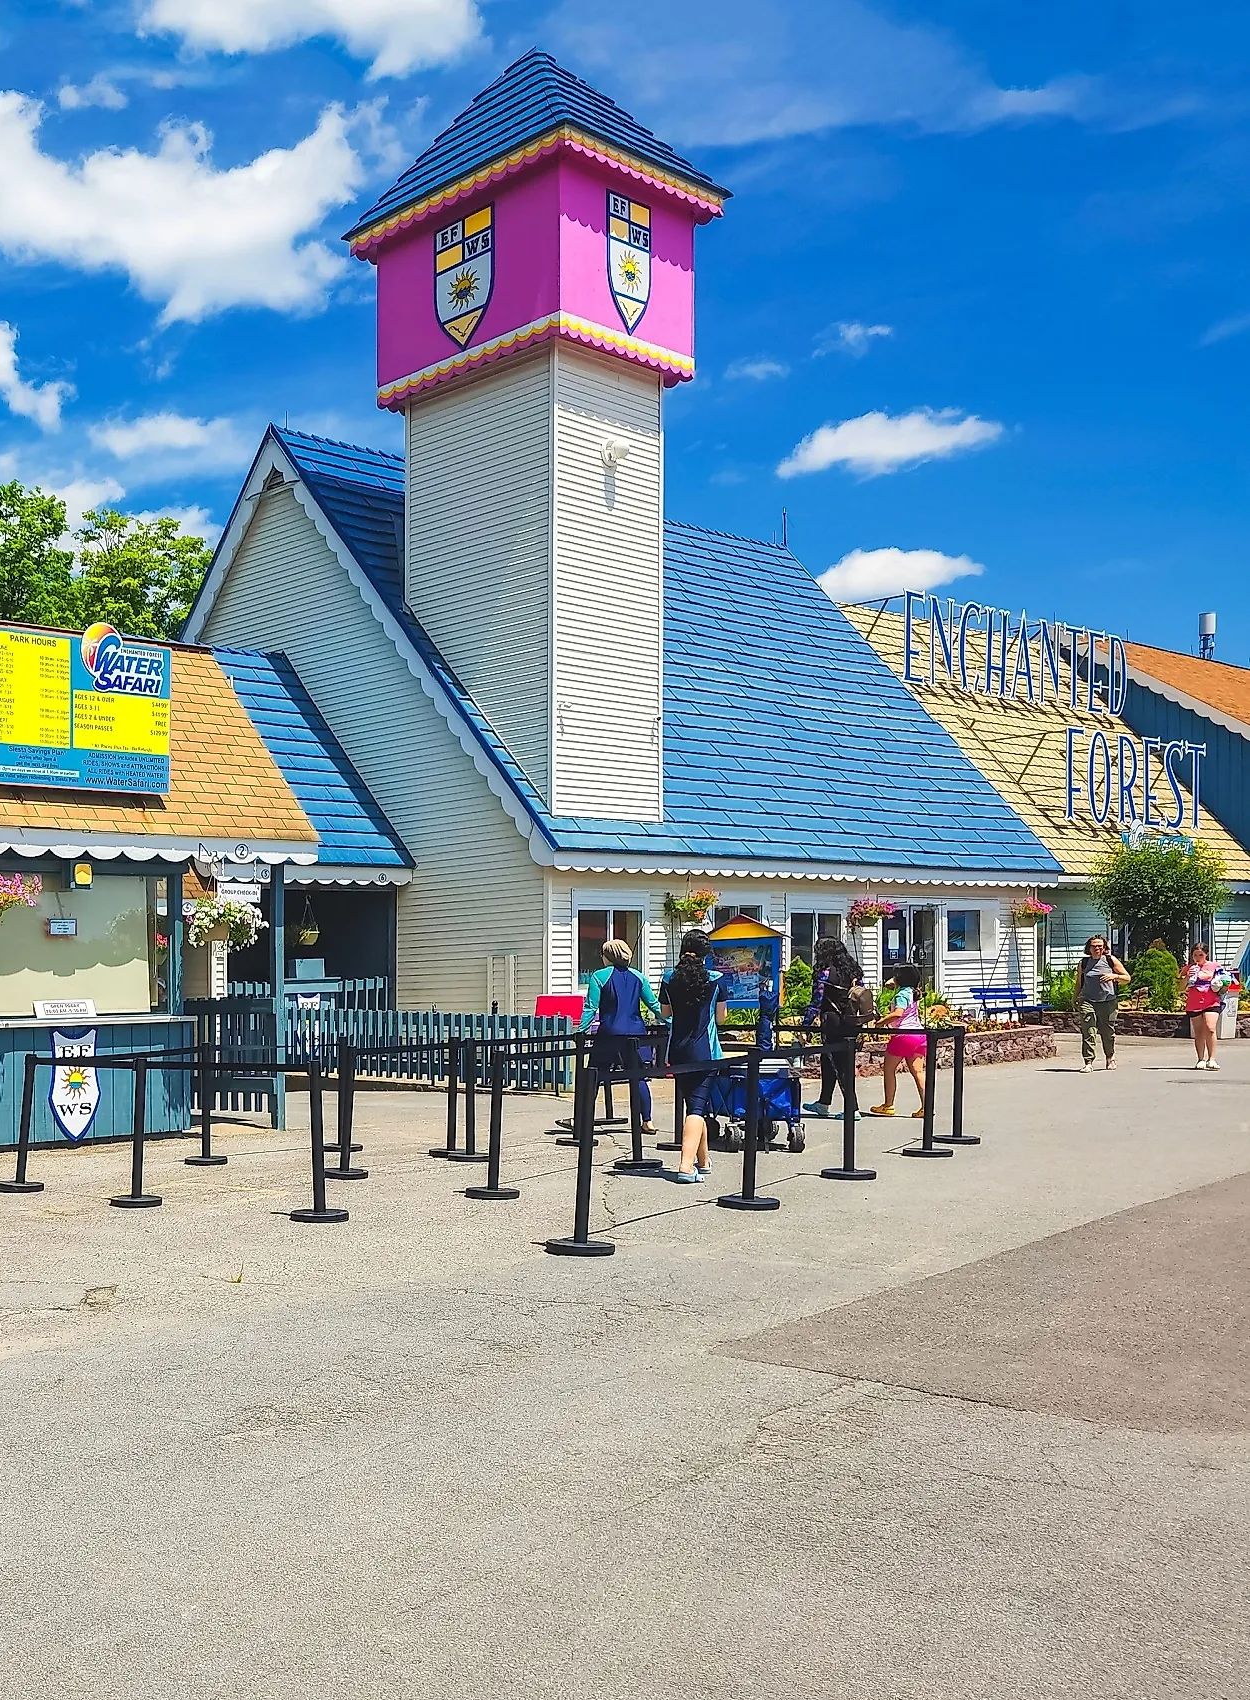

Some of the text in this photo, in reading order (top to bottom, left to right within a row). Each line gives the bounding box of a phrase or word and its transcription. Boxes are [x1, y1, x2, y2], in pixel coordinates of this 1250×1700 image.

[612, 196, 627, 216] EF
[440, 224, 459, 248] EF
[631, 226, 649, 248] WS
[465, 231, 490, 257] WS
[10, 634, 57, 648] PARK HOURS
[93, 634, 163, 677] WATER
[120, 648, 162, 659] ENCHANTED FOREST
[902, 587, 1128, 717] ENCHANTED
[94, 670, 161, 694] SAFARI
[74, 722, 113, 732] SEASON PASSES
[8, 745, 27, 753] Siesta
[27, 747, 50, 756] Savings
[87, 752, 117, 760] ADMISSION
[138, 756, 165, 764] UNLIMITED
[98, 768, 114, 776] RIDES
[125, 770, 146, 778] HEATED
[1063, 725, 1206, 831] FOREST
[84, 776, 168, 789] www.WaterSafari.com
[59, 1044, 92, 1058] EF
[56, 1102, 93, 1116] WS
